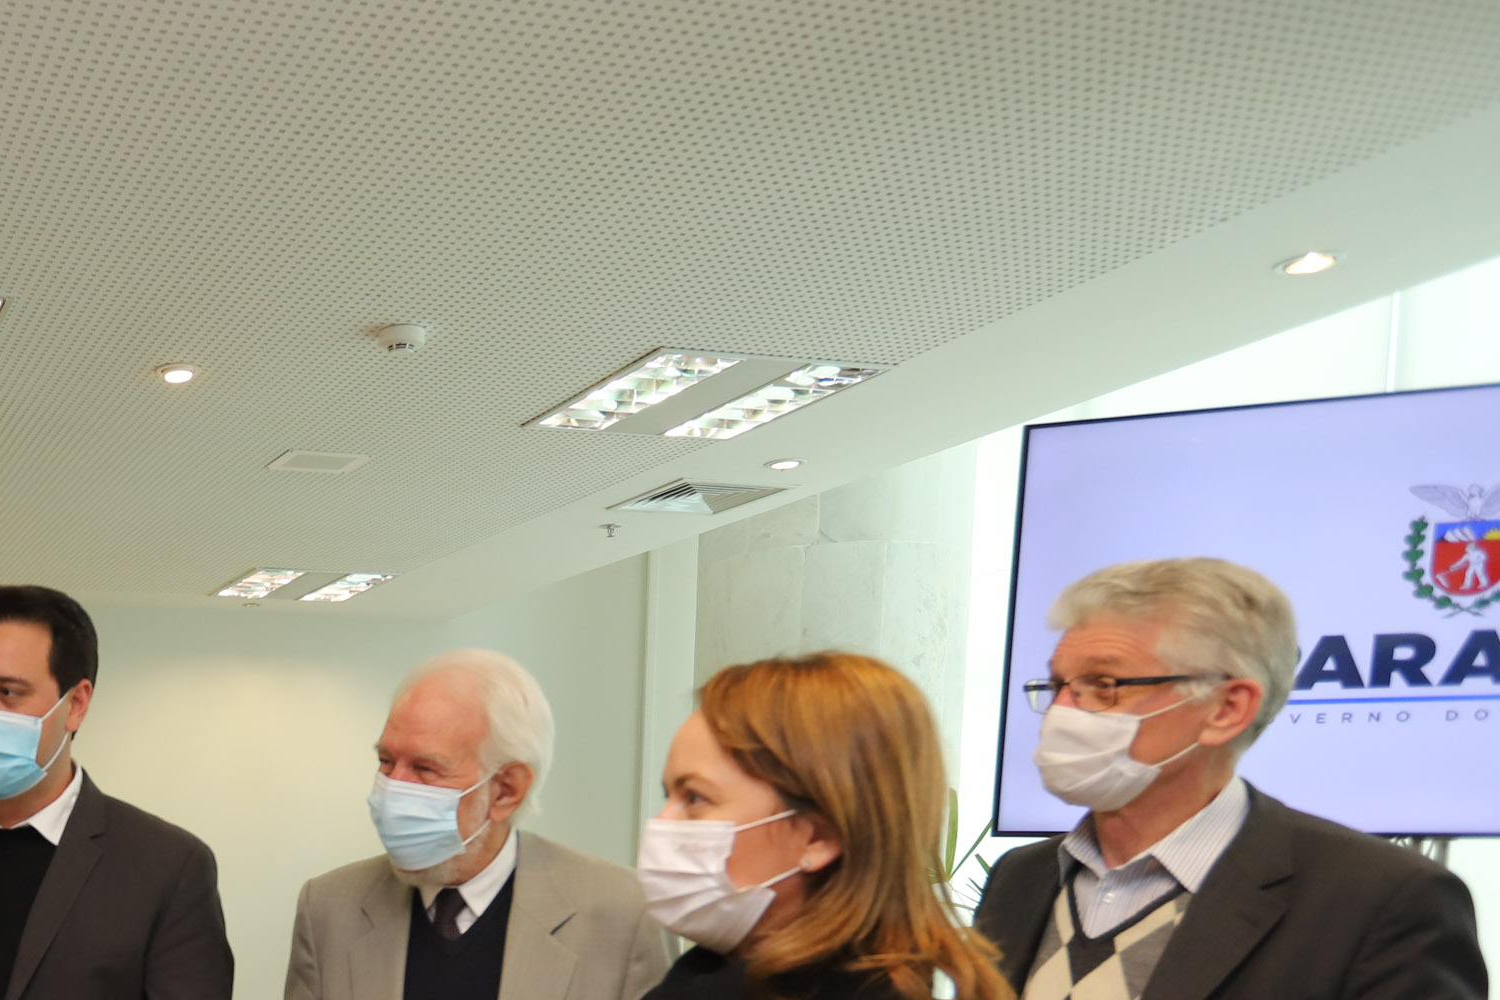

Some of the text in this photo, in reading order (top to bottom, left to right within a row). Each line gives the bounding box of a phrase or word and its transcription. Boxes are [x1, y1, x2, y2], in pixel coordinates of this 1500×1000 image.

[1294, 629, 1500, 690] ARA
[1269, 709, 1490, 725] VERNO DO
